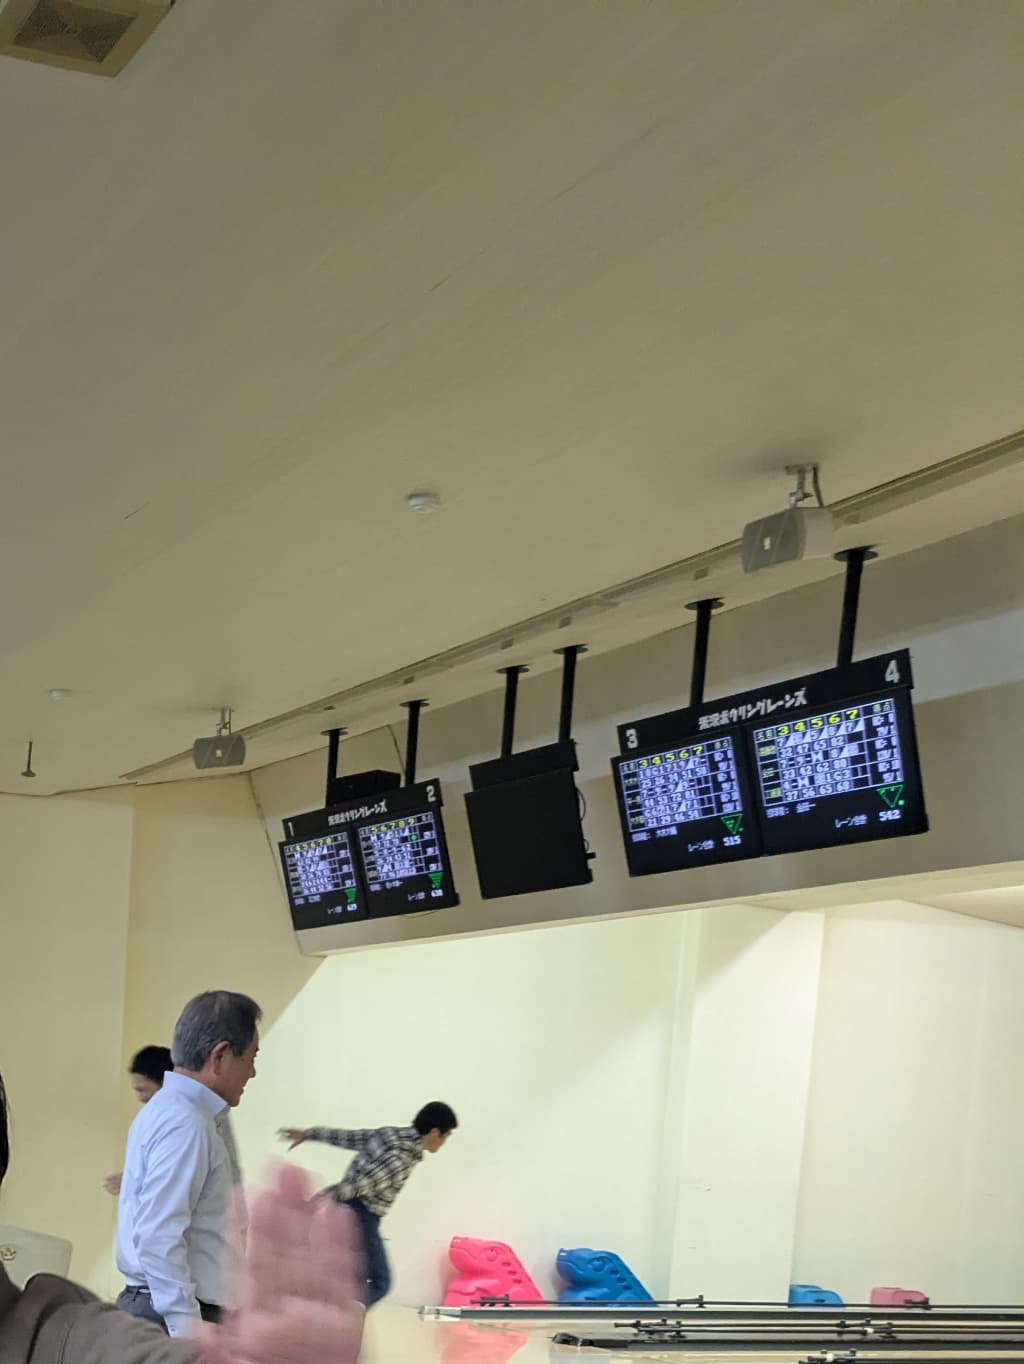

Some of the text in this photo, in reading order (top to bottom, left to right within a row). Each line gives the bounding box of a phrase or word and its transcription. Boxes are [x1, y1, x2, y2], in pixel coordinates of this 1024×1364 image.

[885, 659, 900, 683] 4
[777, 725, 789, 736] 3
[793, 721, 805, 732] 4
[810, 717, 823, 728] 5
[827, 713, 840, 724] 6
[845, 709, 858, 720] 7
[626, 728, 639, 749] 3
[779, 746, 792, 757] 32
[813, 739, 826, 750] 65
[830, 735, 844, 746] 82
[639, 759, 648, 767] 3
[665, 753, 674, 761] 5
[679, 749, 688, 758] 6
[693, 746, 703, 755] 7
[782, 758, 846, 779] 33 42 62 80
[426, 785, 436, 802] 2
[785, 780, 849, 800] 37 56 65 68
[878, 808, 900, 821] 542
[287, 822, 294, 836] 1
